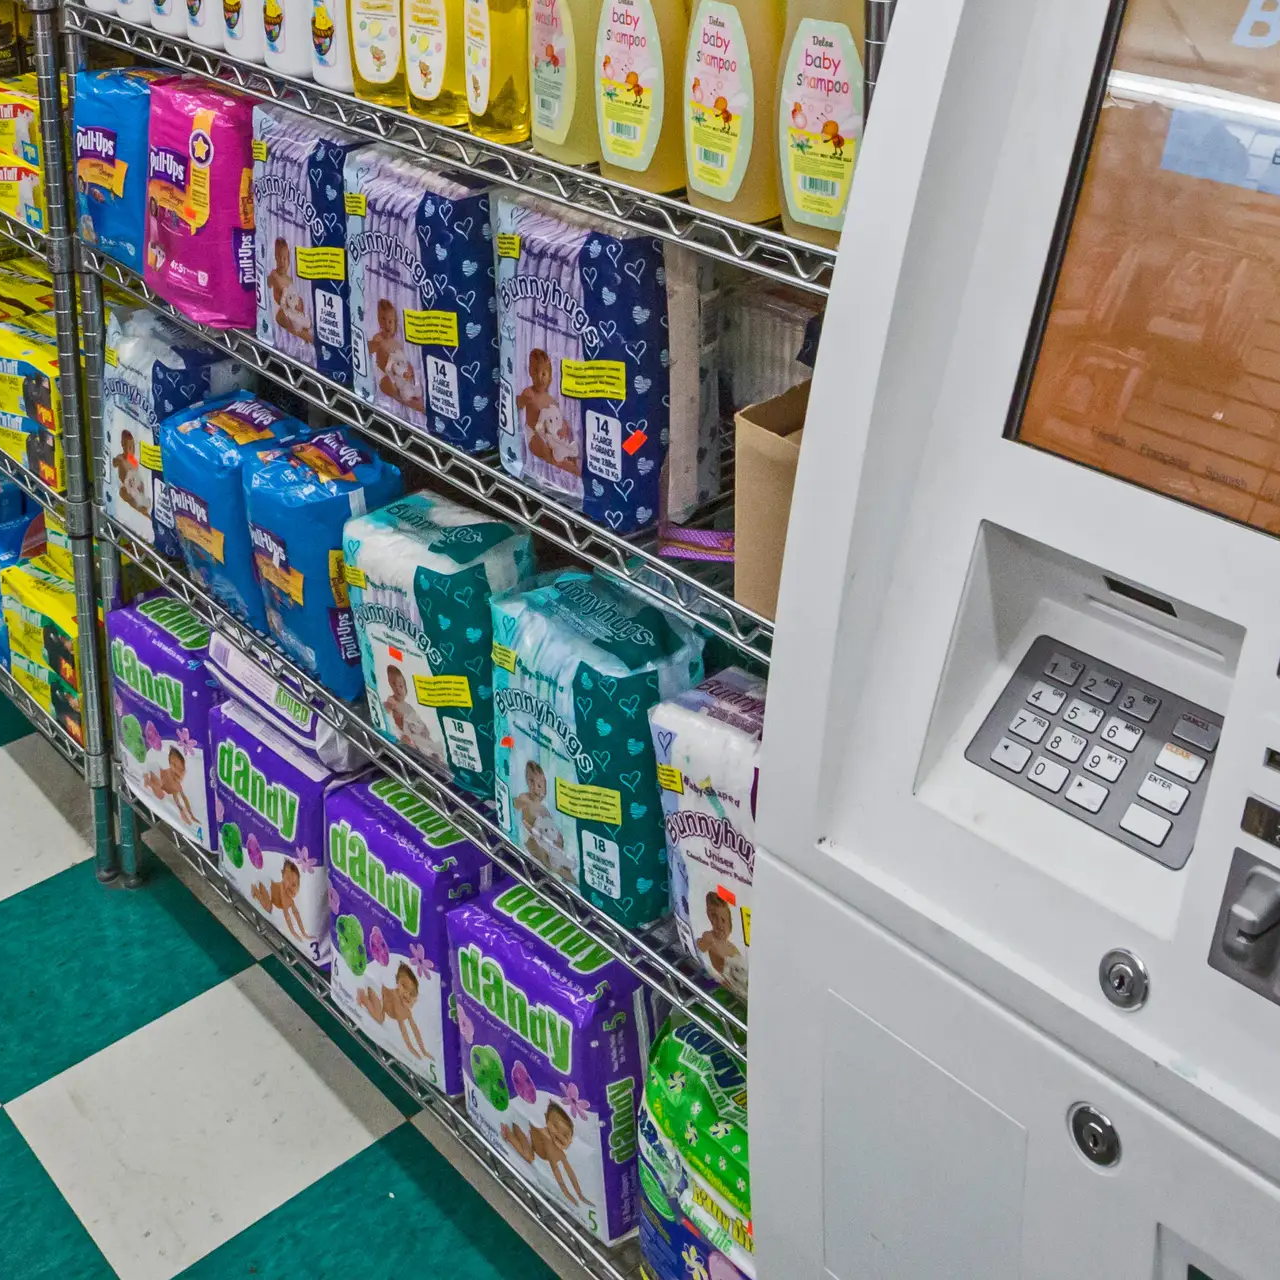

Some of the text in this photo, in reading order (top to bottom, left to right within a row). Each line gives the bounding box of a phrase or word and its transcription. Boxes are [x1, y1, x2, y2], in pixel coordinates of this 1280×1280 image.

[535, 11, 559, 30] wash
[611, 6, 640, 31] baby
[606, 27, 647, 51] shampoo
[702, 27, 731, 56] baby
[695, 50, 737, 74] shampoo
[805, 48, 841, 77] baby
[796, 68, 850, 98] shampoo
[76, 130, 115, 157] Pull-Ups
[150, 151, 185, 181] Pull-Ups
[254, 174, 324, 237] Bunnyhugs
[348, 230, 435, 299] Bunnyhugs
[322, 294, 334, 310] 14
[499, 274, 602, 349] Bunnyhugs
[352, 348, 362, 370] 5
[433, 360, 448, 377] 14
[499, 404, 509, 429] 5
[594, 416, 610, 435] 14
[354, 604, 443, 665] Bunnyhugs
[1049, 662, 1059, 675] 1
[110, 635, 185, 724] dandy
[1085, 677, 1096, 693] 2
[1031, 689, 1044, 703] 4
[1123, 695, 1136, 710] 3
[1032, 716, 1047, 729] PRS
[1067, 705, 1081, 720] 5
[1089, 706, 1102, 719] JKL
[1181, 712, 1211, 732] CANCEL
[451, 719, 465, 735] 18
[494, 686, 595, 774] Bunnyhugs
[1014, 716, 1027, 731] 7
[1106, 724, 1119, 740] 6
[1124, 722, 1142, 737] MNO
[1049, 735, 1063, 750] 8
[1070, 734, 1085, 748] TUV
[1165, 742, 1193, 761] CLEAR
[1088, 754, 1101, 769] 9
[1106, 752, 1125, 767] WXY
[218, 737, 301, 843] dandy
[1147, 773, 1174, 792] ENTER
[194, 825, 205, 843] 4
[591, 834, 608, 854] 18
[703, 845, 735, 871] Unisex
[328, 820, 422, 938] dandy
[309, 940, 321, 962] 3
[457, 942, 574, 1077] dandy
[428, 1062, 438, 1085] 5
[606, 1076, 636, 1166] dandy
[587, 1209, 599, 1233] 5
